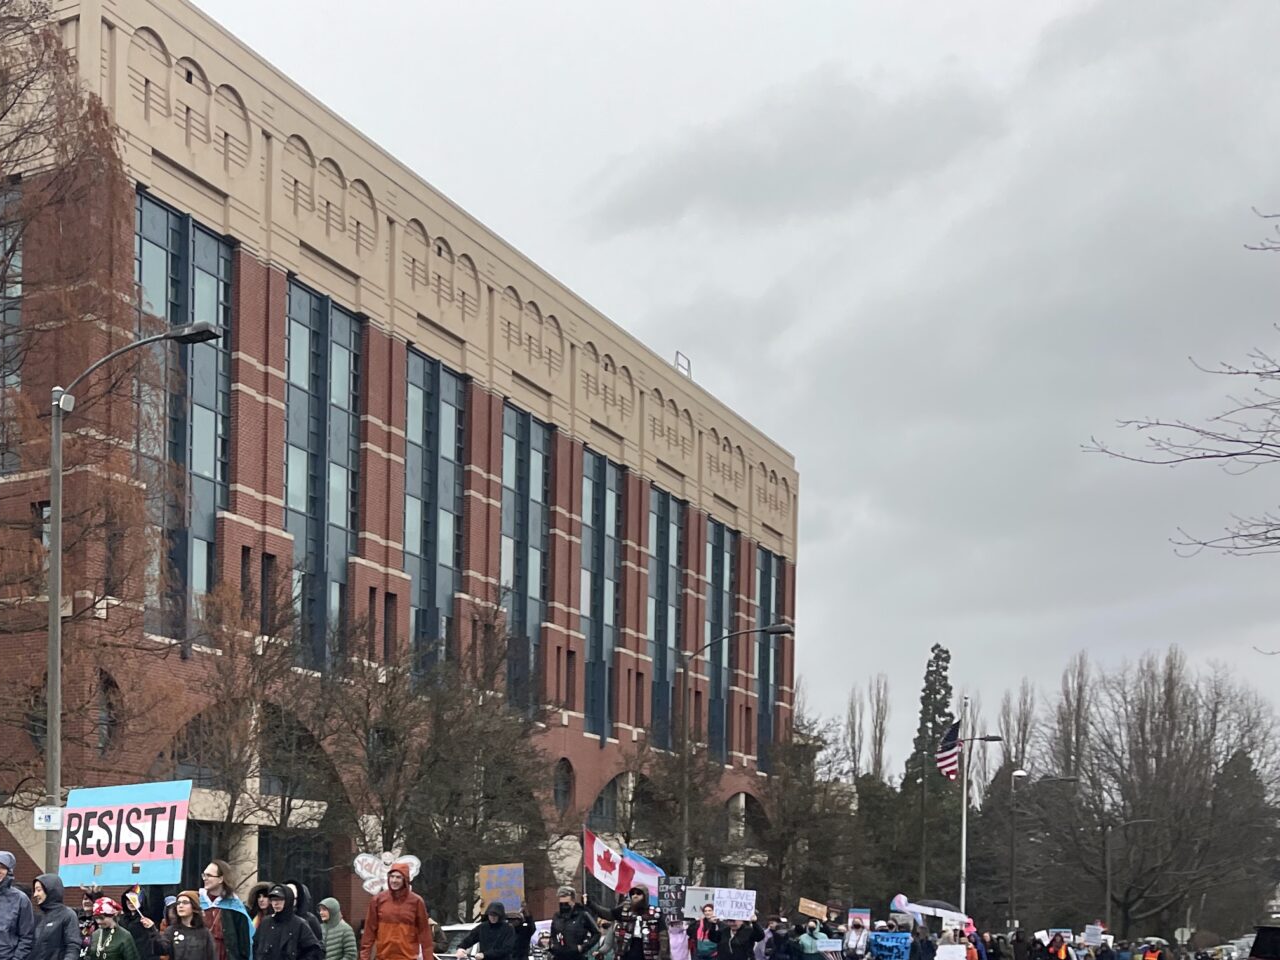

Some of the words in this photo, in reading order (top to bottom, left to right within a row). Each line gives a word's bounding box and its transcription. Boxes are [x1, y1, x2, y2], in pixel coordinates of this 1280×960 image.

[64, 805, 177, 858] RESIST!
[664, 892, 683, 900] ONE
[730, 900, 754, 911] TRANS
